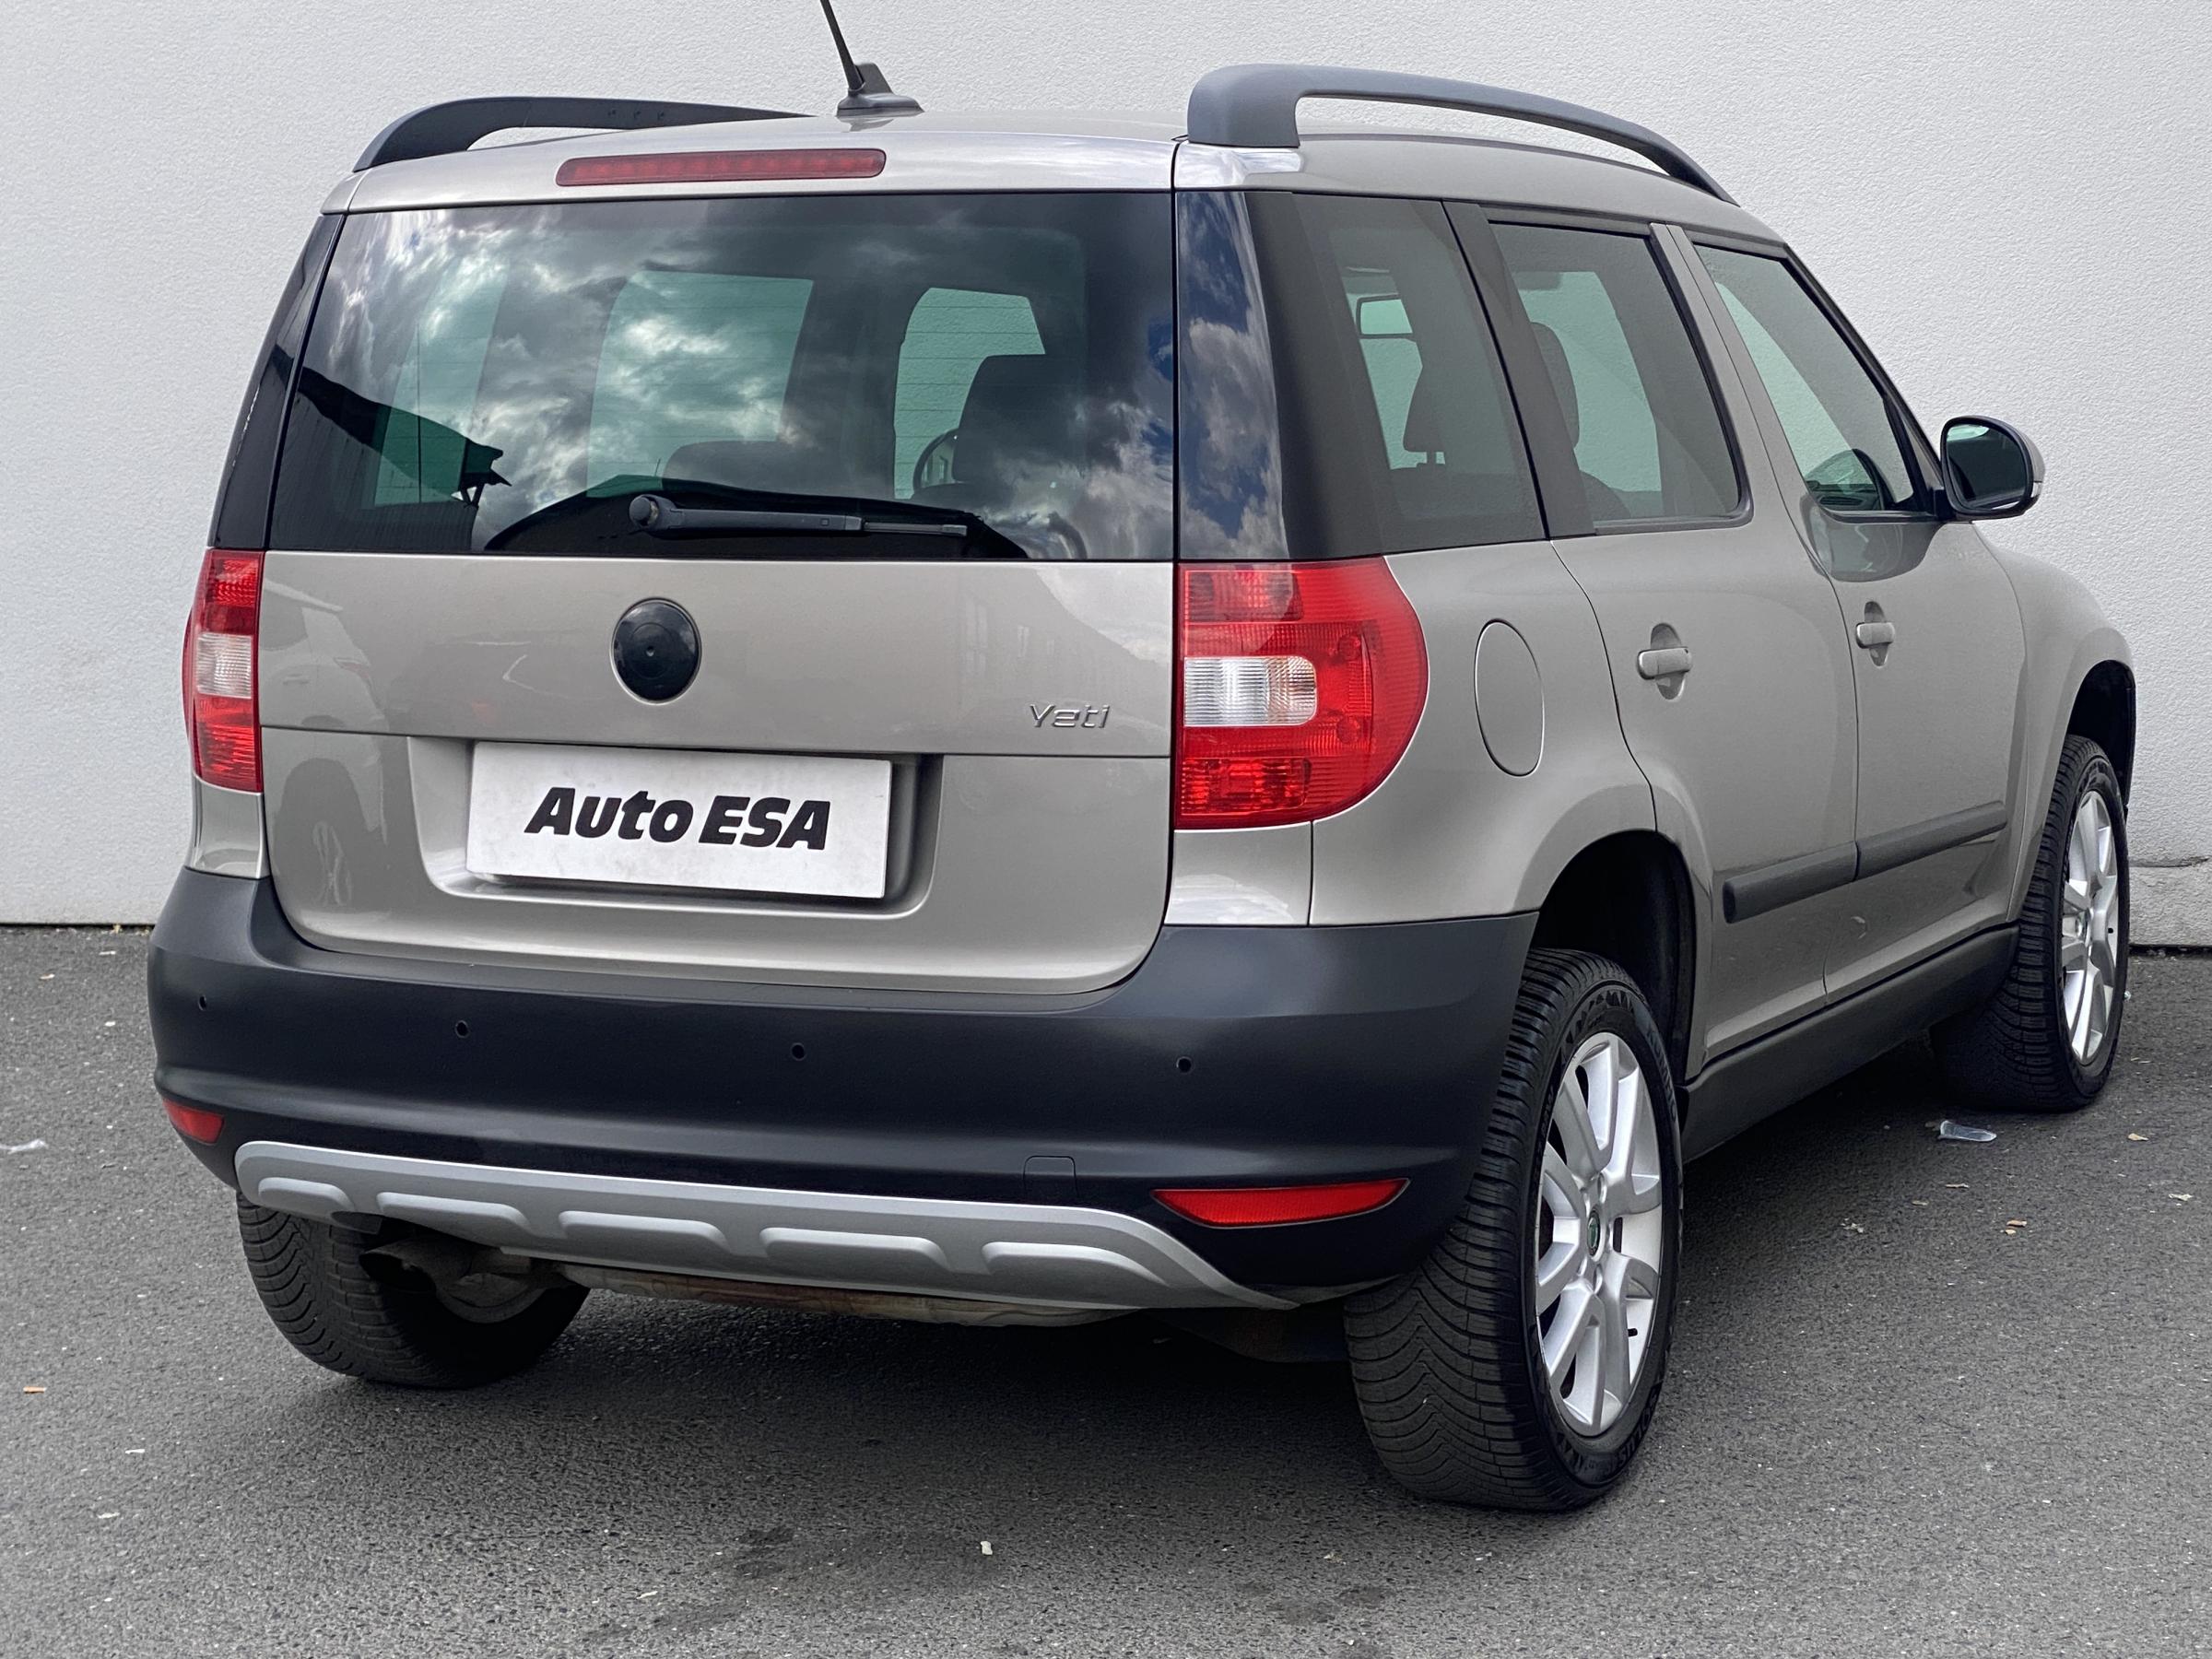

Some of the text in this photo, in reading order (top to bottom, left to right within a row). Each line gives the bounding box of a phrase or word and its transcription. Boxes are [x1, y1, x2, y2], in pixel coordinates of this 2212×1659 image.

[1030, 703, 1110, 728] Yeti
[524, 786, 831, 851] Auto ESA
